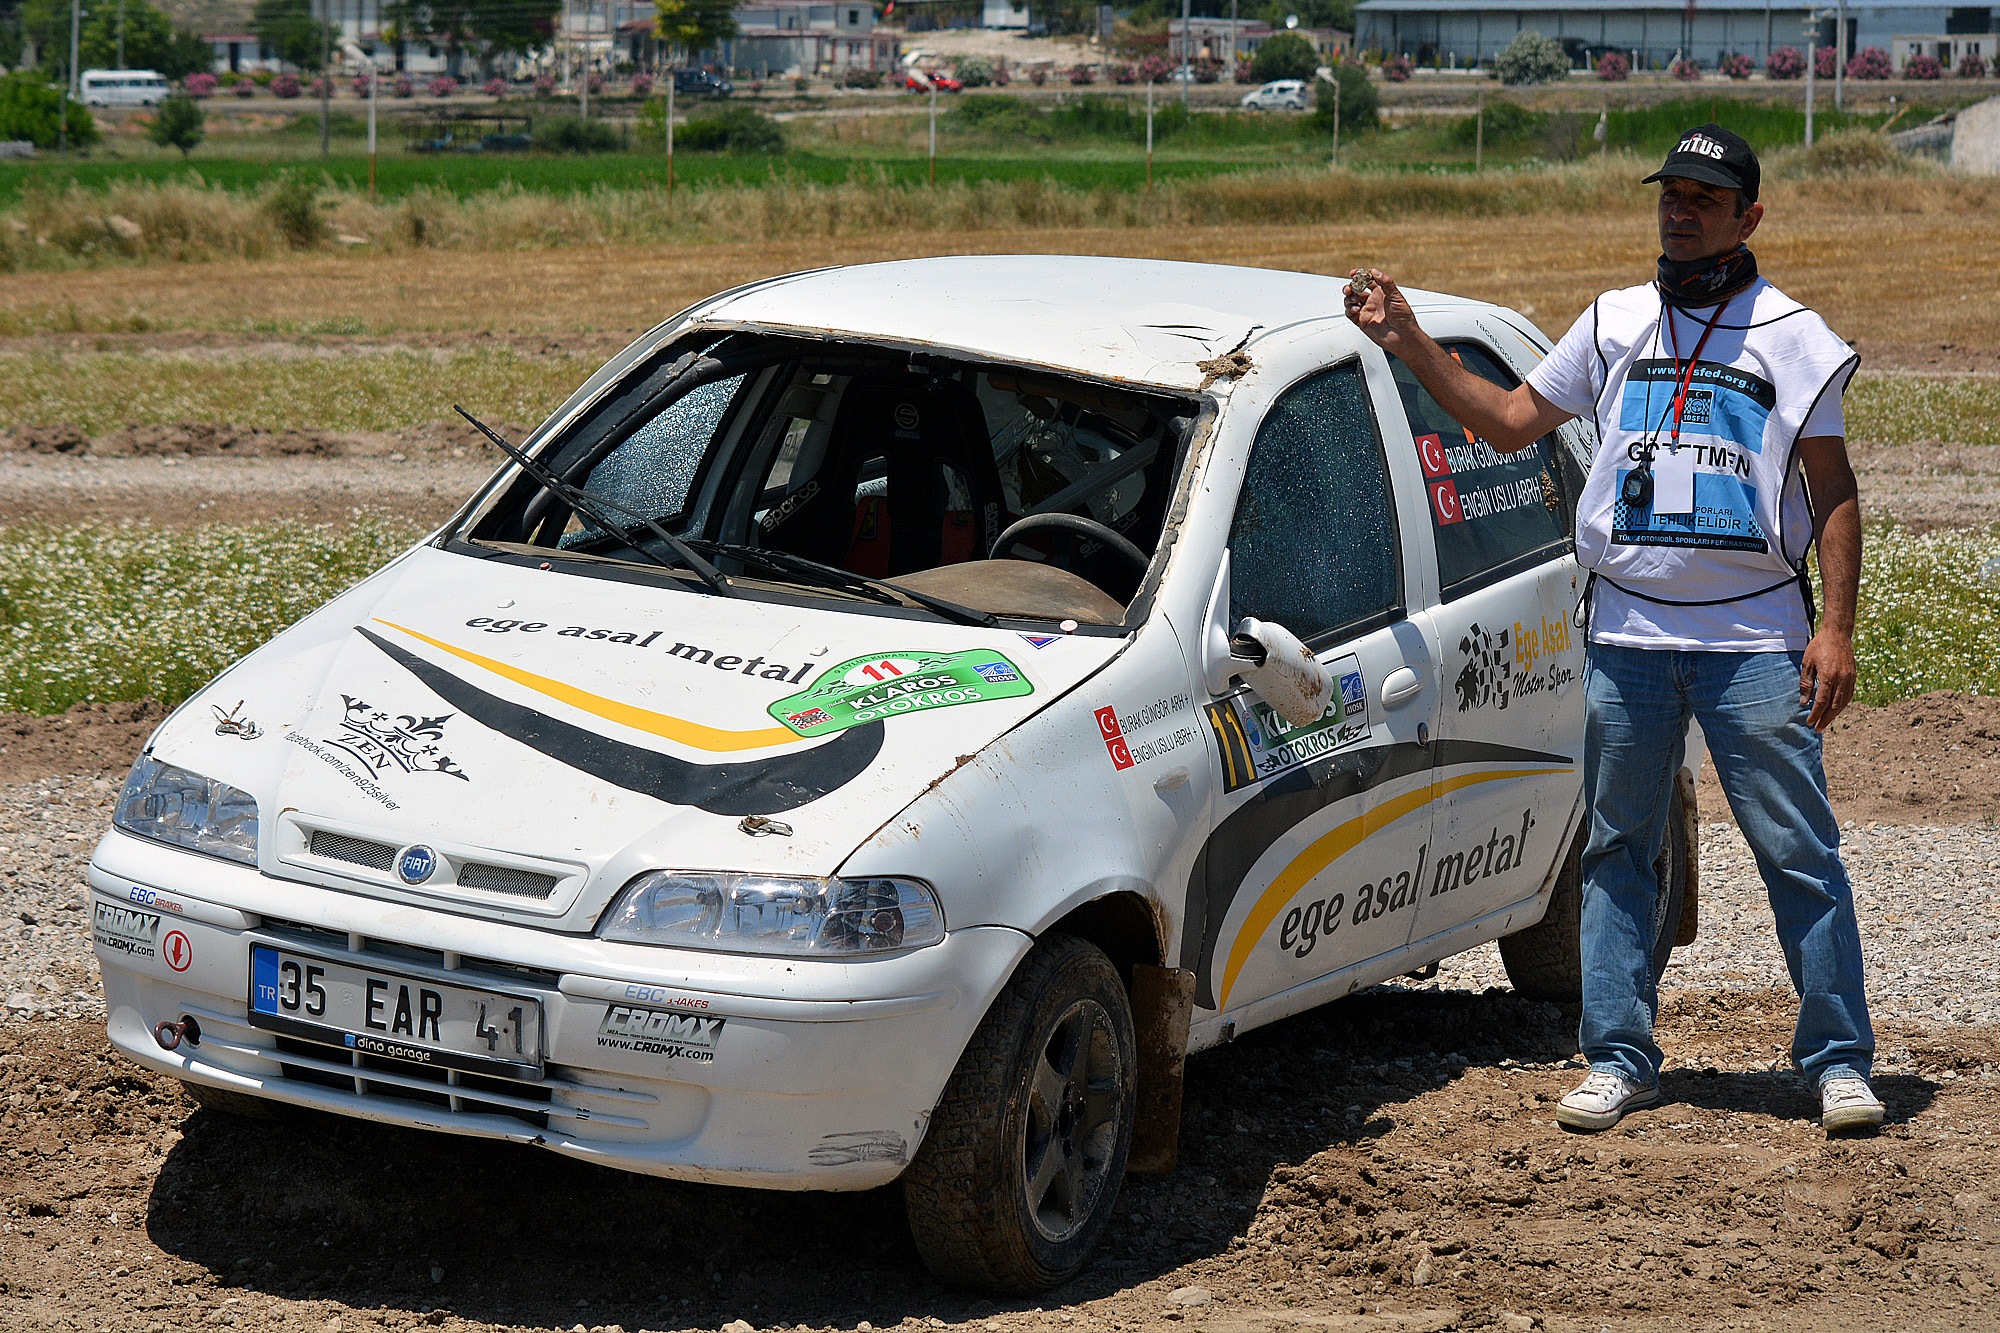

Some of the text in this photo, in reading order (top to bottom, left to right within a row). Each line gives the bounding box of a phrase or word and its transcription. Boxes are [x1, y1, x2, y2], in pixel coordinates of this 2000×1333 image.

[1444, 444, 1479, 474] BURAK
[762, 480, 819, 530] sparco
[1459, 476, 1543, 520] ENGİN USLU ABRH
[986, 502, 1000, 549] sparc
[465, 615, 815, 686] ege asal metal
[1513, 609, 1570, 673] Ege Asal
[862, 660, 904, 681] 11
[1512, 663, 1576, 698] Motor Spor
[848, 675, 958, 710] KLAROS
[853, 687, 983, 722] OTOKROS
[1119, 711, 1144, 735] BURAK
[1141, 698, 1171, 725] GÜNGÖR
[1170, 693, 1185, 713] ARH
[337, 733, 392, 769] ZEN
[1131, 741, 1157, 764] ENGİN
[1154, 734, 1175, 755] USLU
[1172, 727, 1194, 748] ABRH
[1211, 703, 1255, 787] 11
[1278, 727, 1336, 765] OTOKROS
[284, 731, 401, 811] facebook.com/zen925silver
[403, 856, 430, 874] FIAT
[1279, 808, 1531, 958] ege asal metal
[129, 886, 184, 913] EBC BRAKES
[95, 903, 157, 938] CROMX
[93, 933, 155, 957] www.CROMX.com
[258, 984, 276, 1001] TR
[279, 960, 524, 1054] 35 EAR 41
[624, 984, 666, 1003] EBC
[607, 1007, 721, 1043] CROMX
[357, 1037, 432, 1062] dino garage
[596, 1036, 714, 1061] www.CROMX.com
